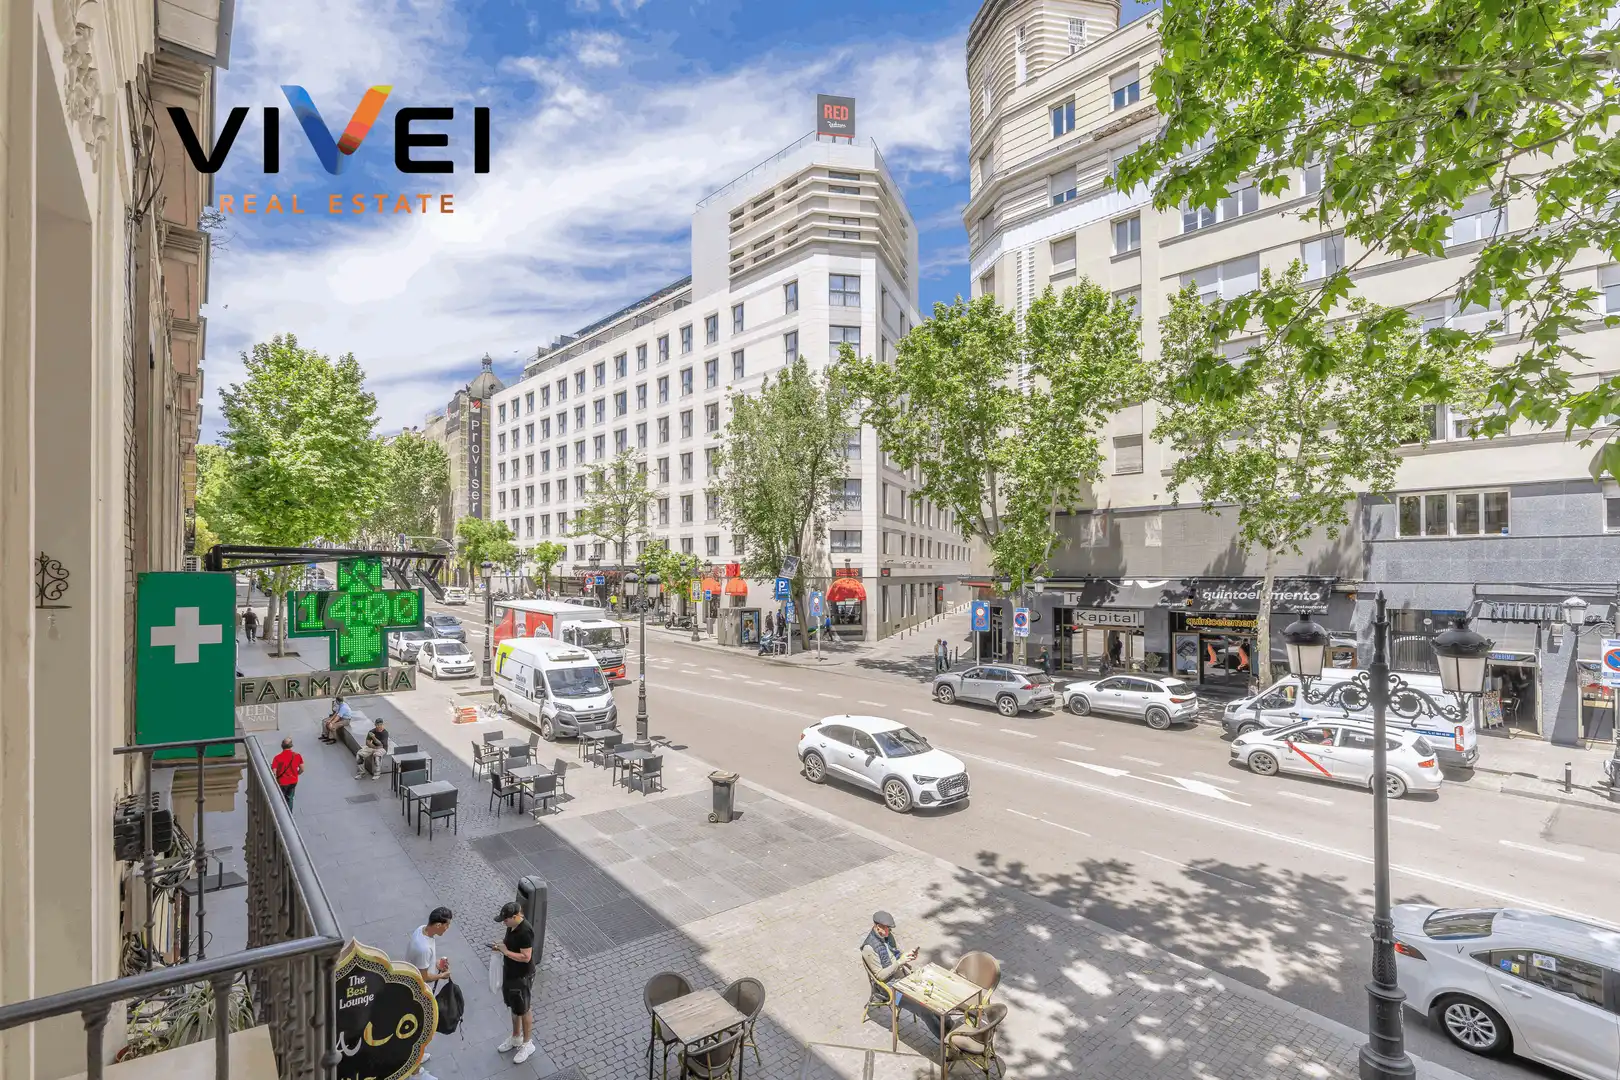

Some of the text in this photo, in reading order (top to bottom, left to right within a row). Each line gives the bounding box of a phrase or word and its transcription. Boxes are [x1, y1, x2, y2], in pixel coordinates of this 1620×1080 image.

[823, 104, 849, 121] RED
[471, 420, 481, 512] Proviser
[1203, 590, 1320, 601] quintoelmento
[1076, 611, 1137, 624] Kapital
[1185, 616, 1258, 628] quintoelement
[240, 670, 413, 704] FARMACIA
[348, 974, 366, 987] The
[346, 985, 368, 998] Best
[339, 993, 375, 1010] Lounge
